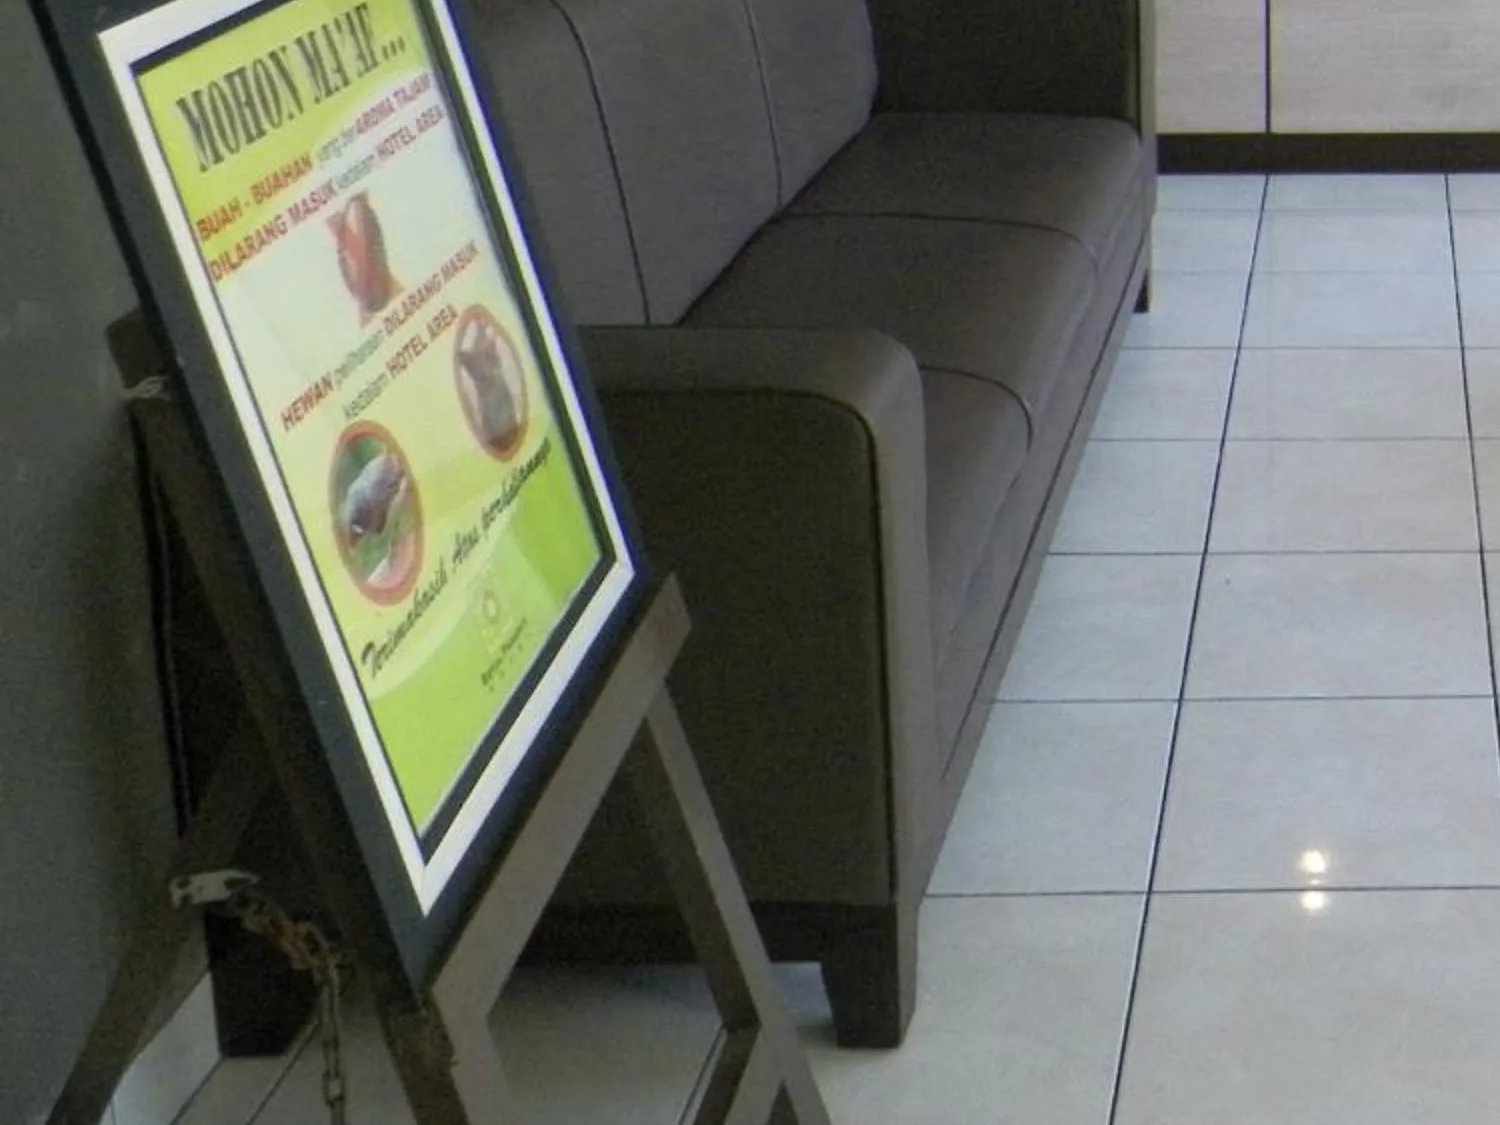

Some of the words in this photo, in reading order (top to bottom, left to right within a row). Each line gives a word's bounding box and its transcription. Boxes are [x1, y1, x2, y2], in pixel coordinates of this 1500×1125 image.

[176, 45, 304, 172] MOHON
[197, 196, 243, 242] BUAH
[250, 151, 313, 205] BUAHAN
[208, 214, 289, 282] DILARANG
[287, 178, 338, 226] MASUK
[375, 126, 417, 161] HOTEL
[415, 103, 446, 133] AREA
[280, 371, 334, 433] HEWAN
[382, 272, 443, 336] DILARANG
[440, 239, 480, 284] MASUK
[385, 334, 429, 379] HOTEL
[425, 303, 459, 341] AREA
